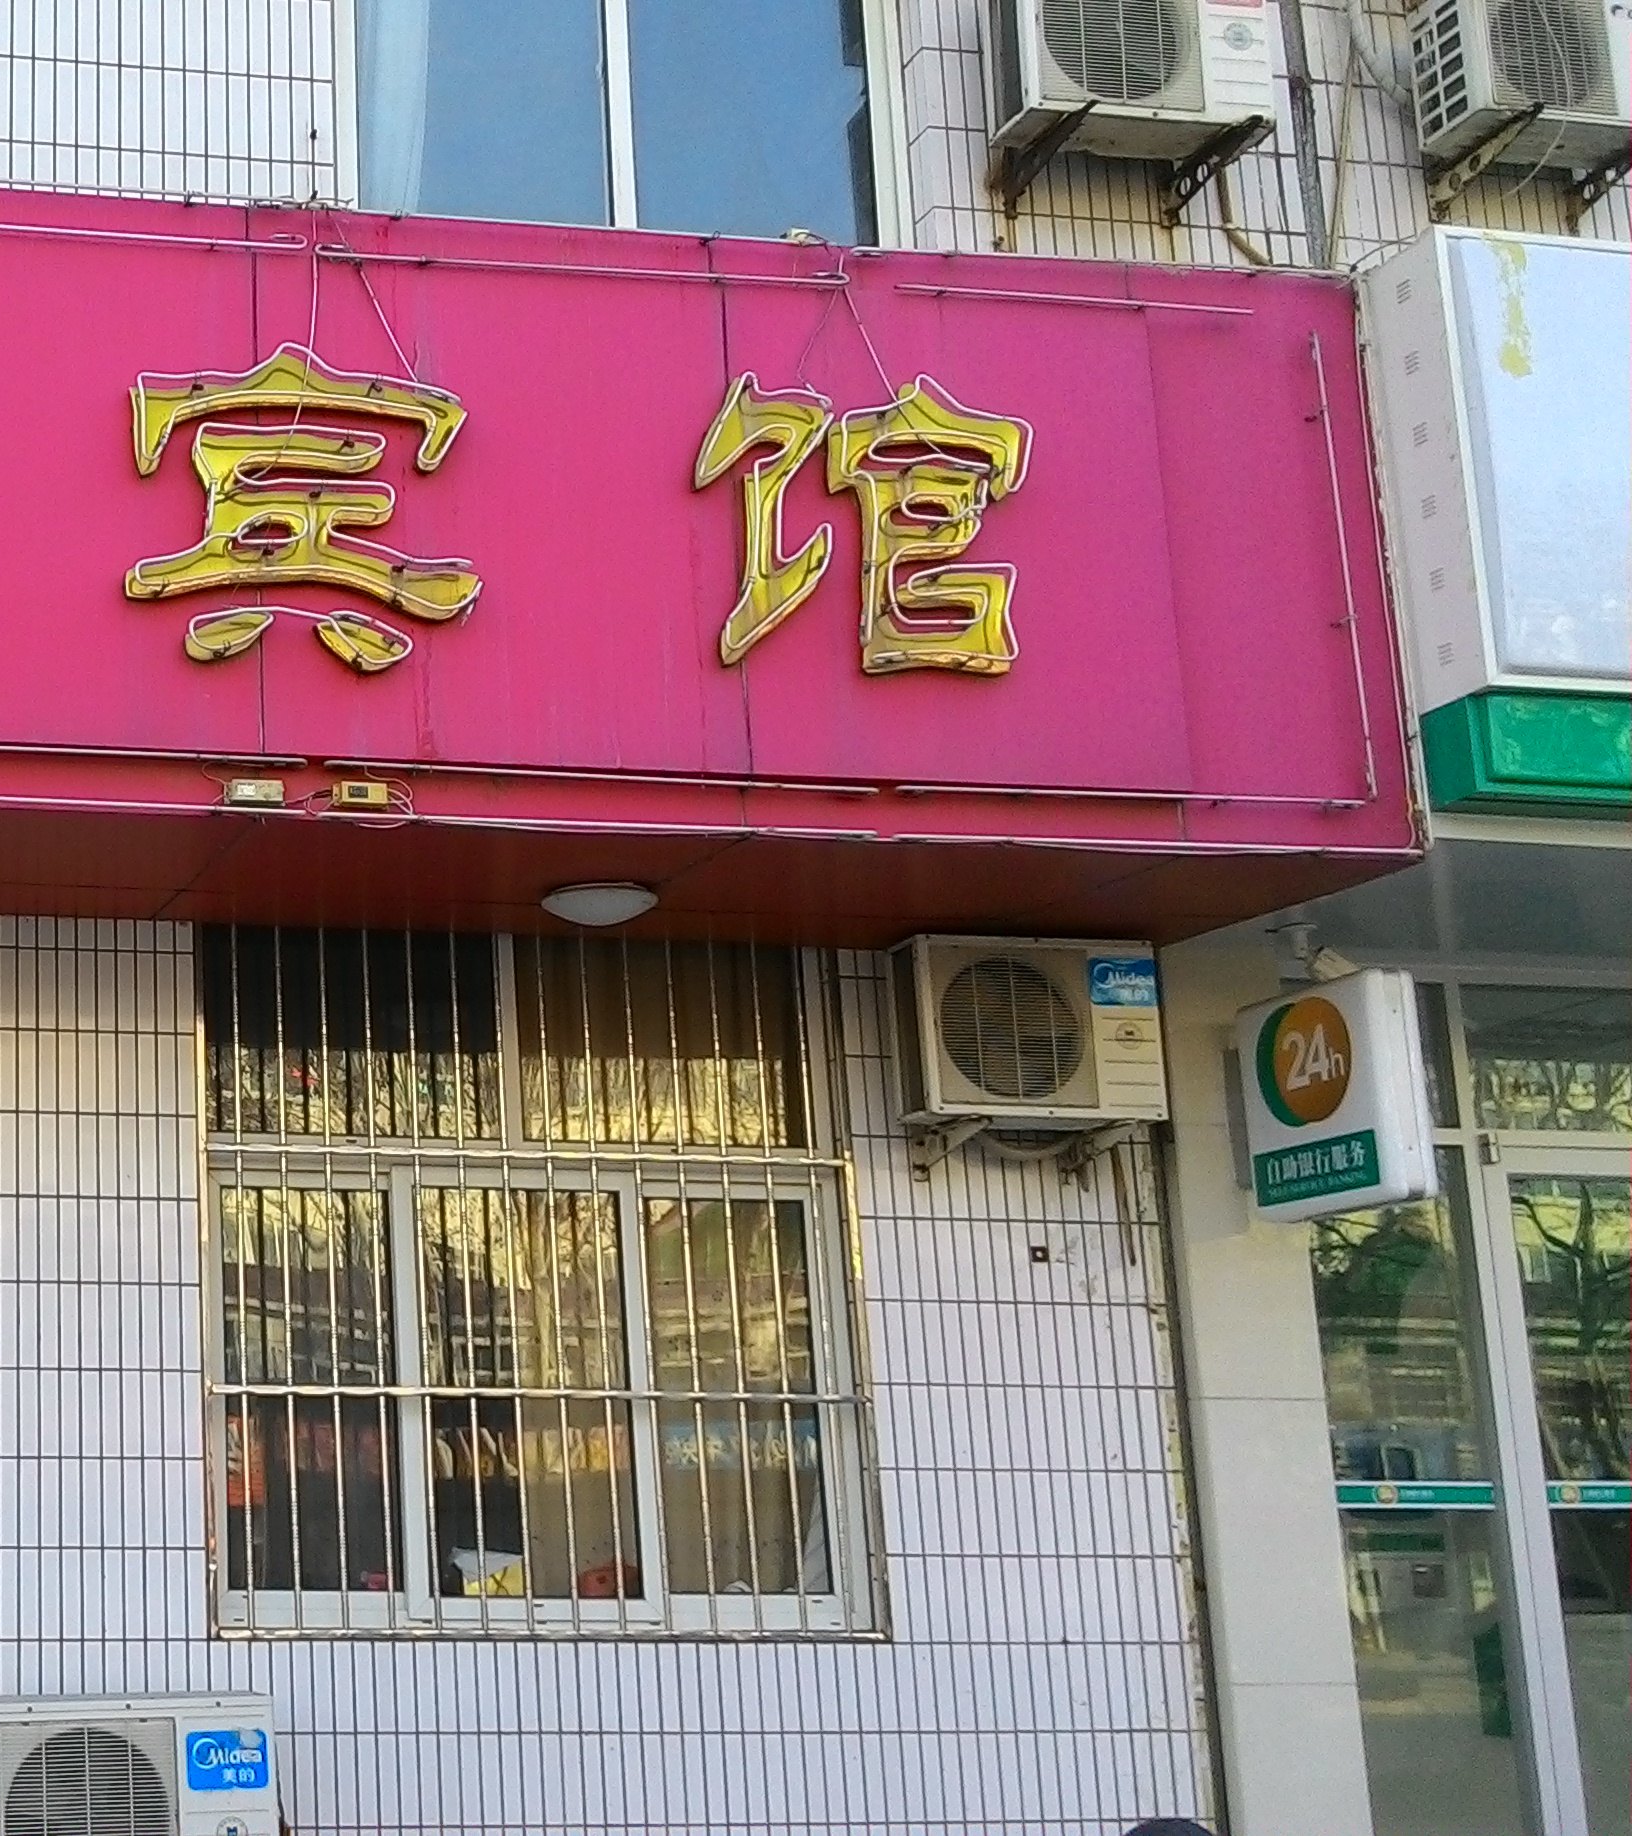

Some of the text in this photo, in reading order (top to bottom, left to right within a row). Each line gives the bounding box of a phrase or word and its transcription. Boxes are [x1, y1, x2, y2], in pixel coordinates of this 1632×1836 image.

[1281, 1023, 1345, 1091] 24h
[1268, 1140, 1365, 1185] 自助银行服务
[196, 1742, 262, 1766] Midea
[222, 1767, 256, 1783] 美的
